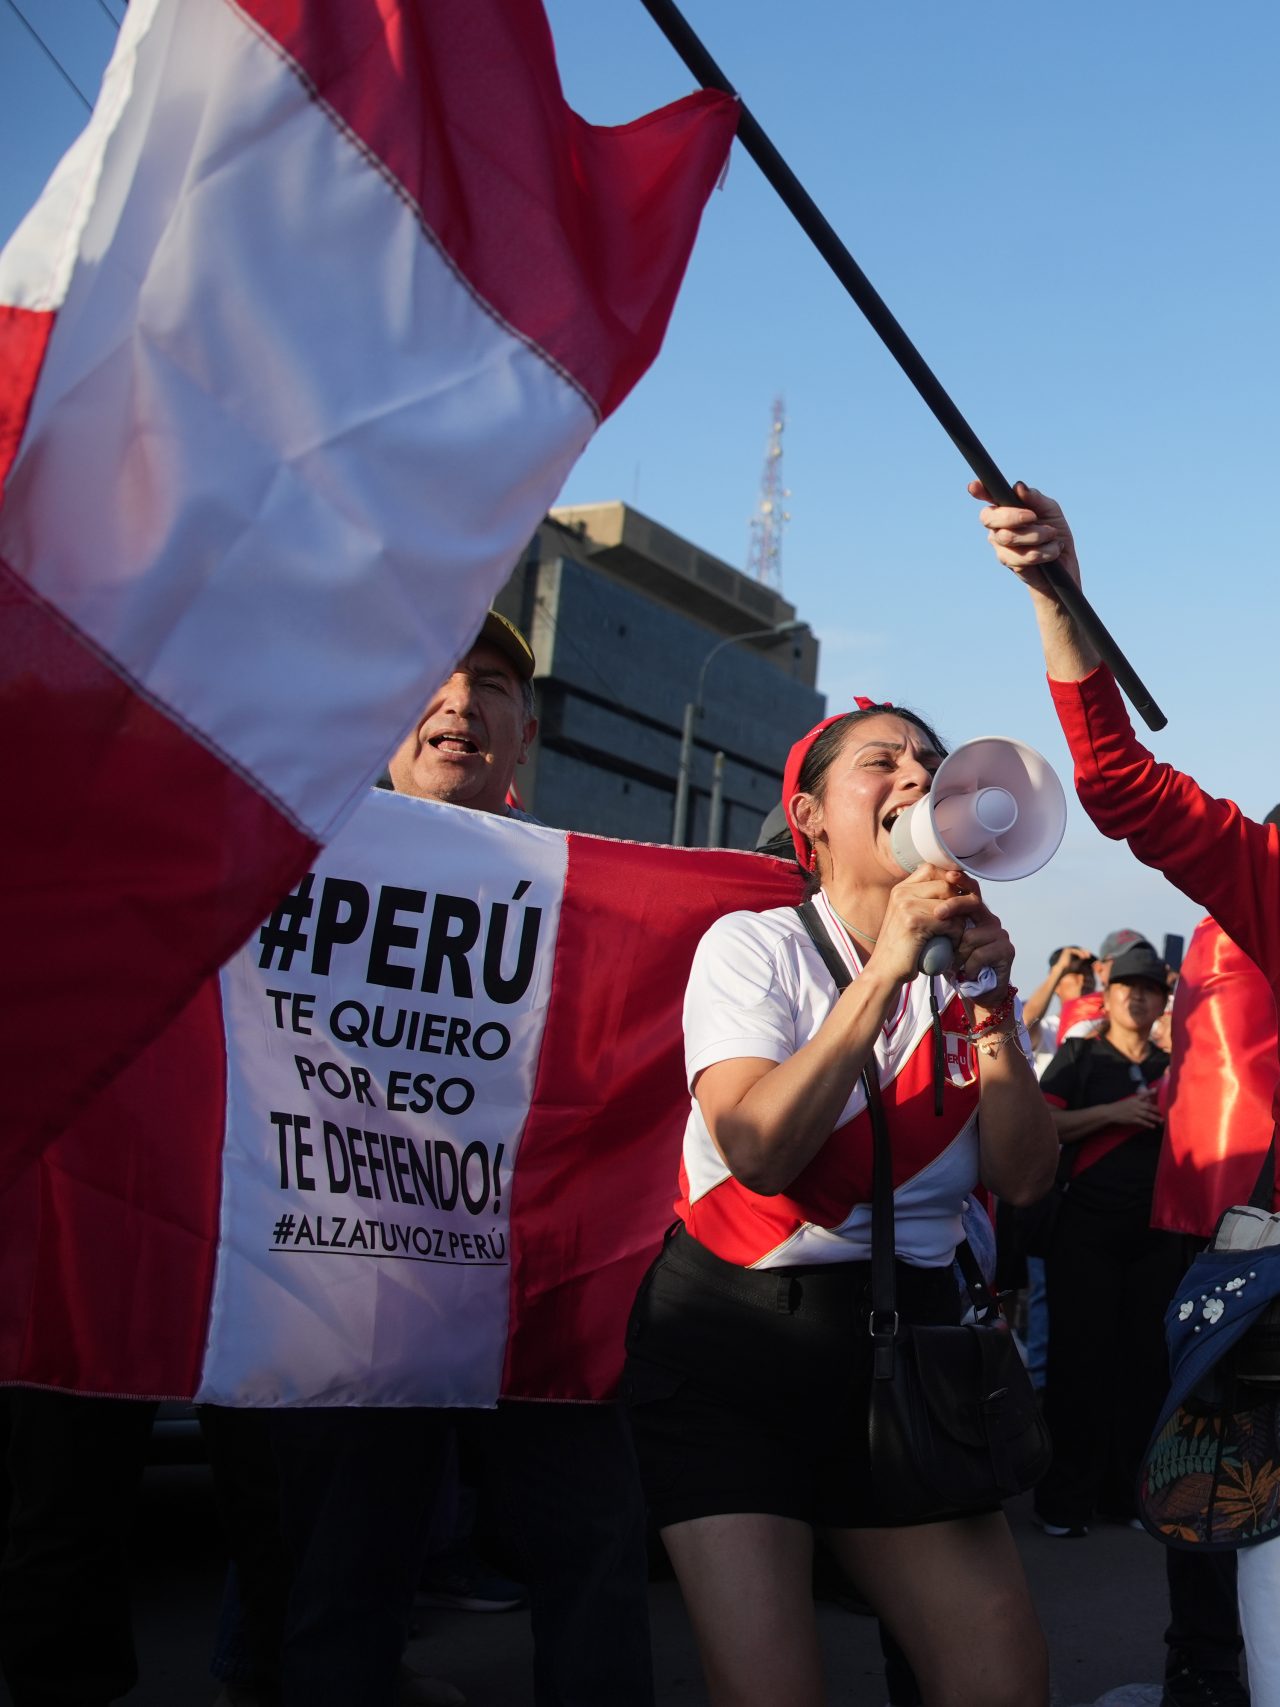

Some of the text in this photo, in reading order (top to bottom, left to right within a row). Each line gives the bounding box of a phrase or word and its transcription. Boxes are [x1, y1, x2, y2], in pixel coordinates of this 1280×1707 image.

[259, 873, 542, 1004] #PERÚ
[266, 989, 511, 1061] TE QUIERO
[944, 1053, 966, 1065] ERU
[294, 1055, 475, 1115] POR ESO
[270, 1112, 505, 1215] TE DEFIENDO!
